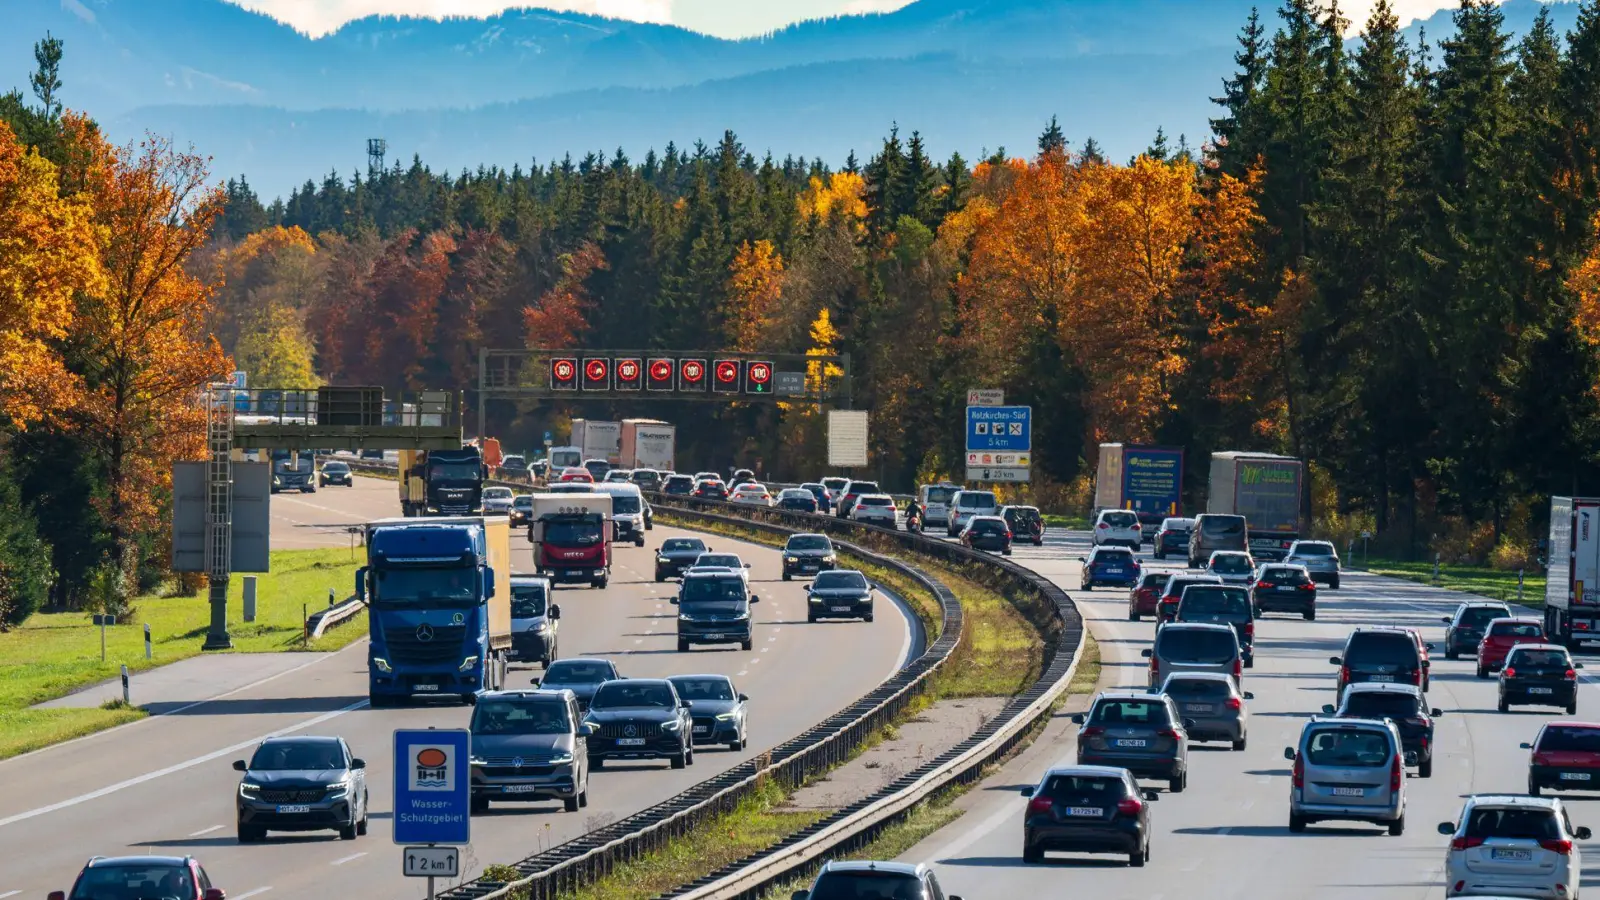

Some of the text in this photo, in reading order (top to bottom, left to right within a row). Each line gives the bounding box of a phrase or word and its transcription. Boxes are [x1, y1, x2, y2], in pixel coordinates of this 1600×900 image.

[558, 365, 570, 376] 100
[622, 365, 634, 376] 100
[687, 366, 699, 376] 100
[754, 368, 766, 379] 100
[988, 438, 1008, 446] 5 km
[1003, 470, 1014, 478] km
[411, 799, 453, 809] Wasser-
[400, 813, 463, 824] Schutzgebiet
[420, 858, 445, 870] 2 km
